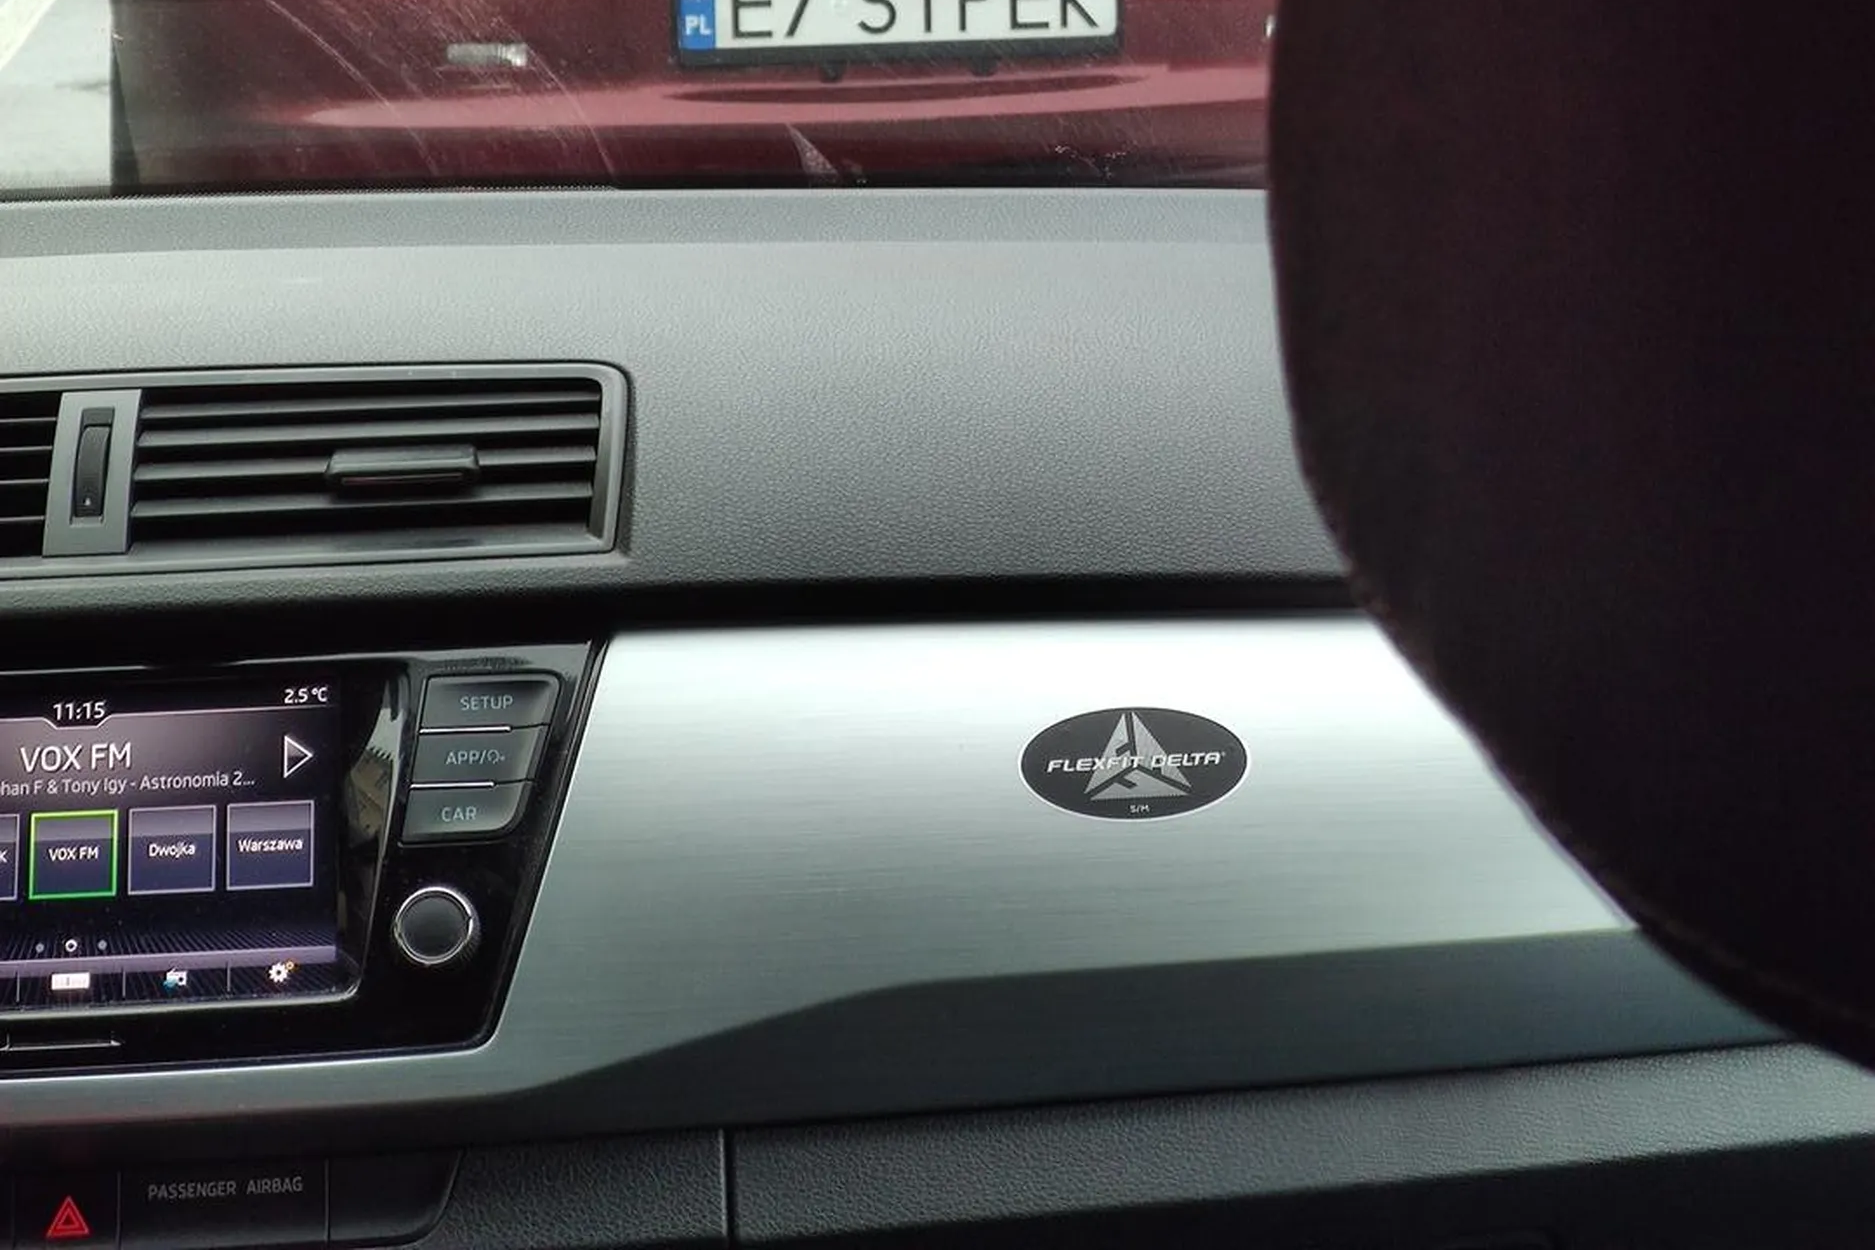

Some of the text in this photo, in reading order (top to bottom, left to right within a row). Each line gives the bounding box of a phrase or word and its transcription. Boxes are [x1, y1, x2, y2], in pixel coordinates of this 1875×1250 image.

[685, 14, 711, 35] PL
[53, 701, 105, 720] 11:15
[460, 695, 513, 711] SETUP
[20, 742, 132, 772] VOX FM
[1047, 755, 1145, 773] FLEXFIT
[1, 780, 29, 796] han
[34, 780, 43, 795] F
[47, 778, 58, 795] &
[61, 777, 100, 797] Tony
[103, 776, 126, 795] Igy
[139, 771, 229, 790] Astronomia
[441, 806, 477, 822] CAR
[49, 845, 99, 862] VOX FM
[237, 836, 304, 853] Warszawa
[148, 1176, 304, 1200] PASSENGER AIRBAG
